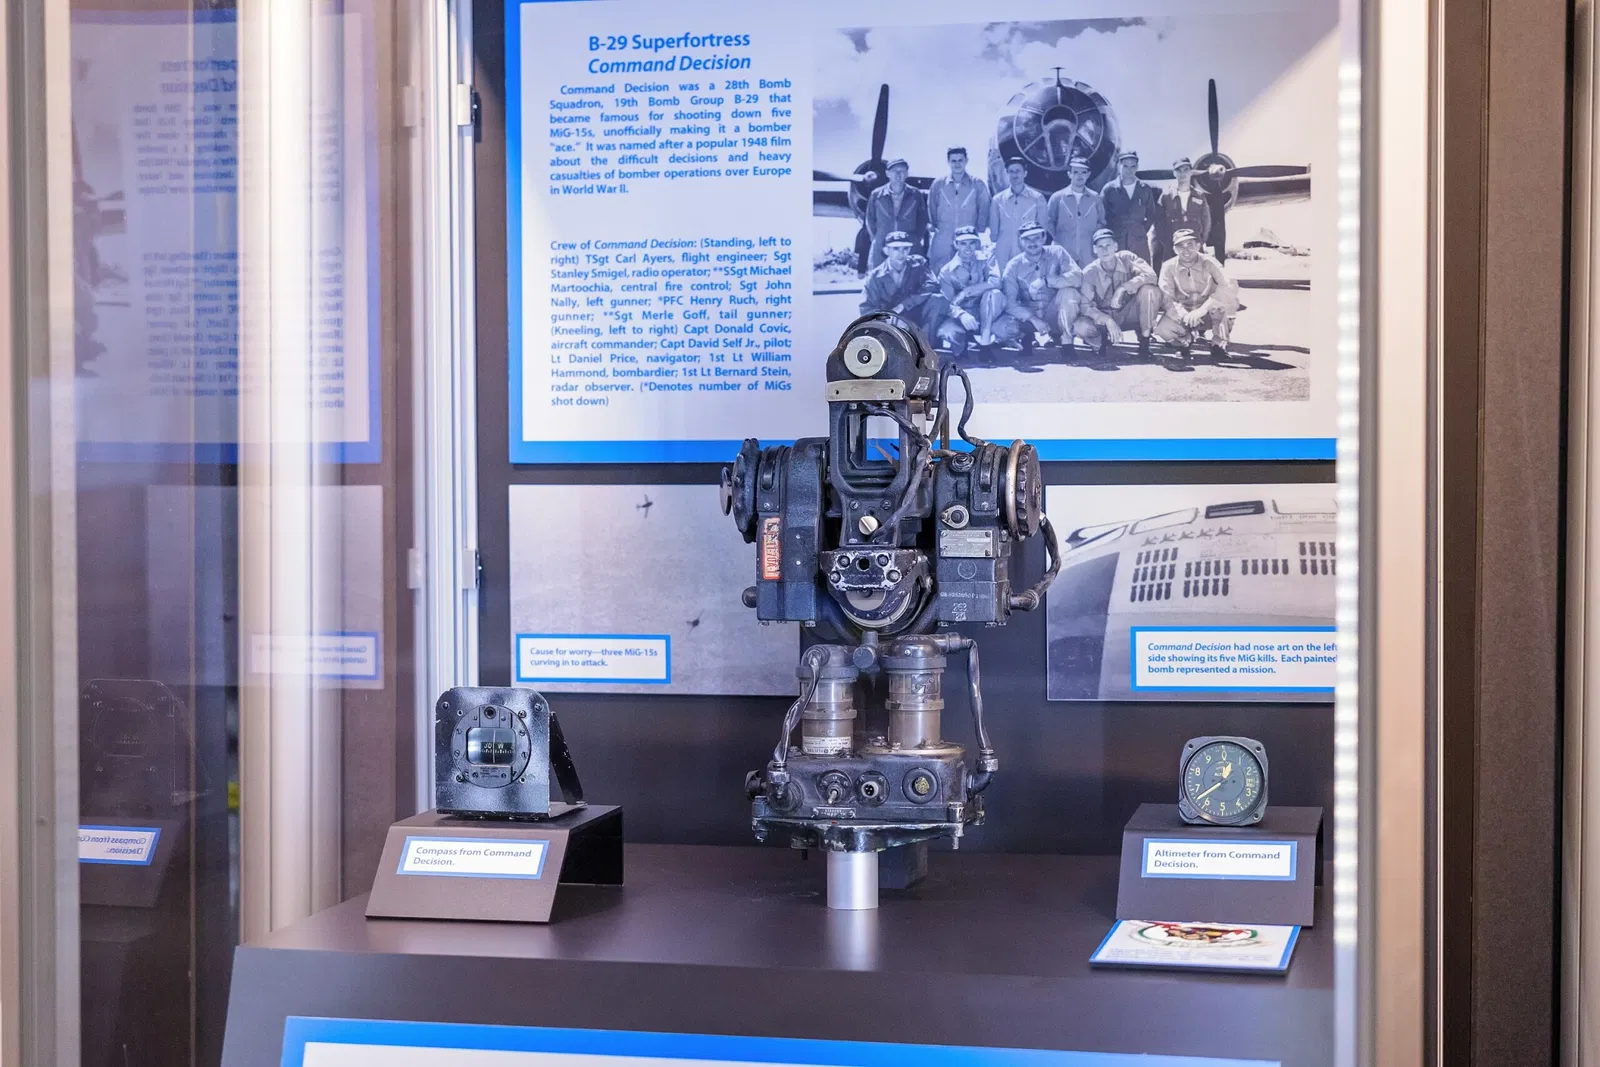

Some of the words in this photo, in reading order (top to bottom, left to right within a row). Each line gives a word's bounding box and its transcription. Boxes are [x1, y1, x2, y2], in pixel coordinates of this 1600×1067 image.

[589, 35, 628, 51] B-29
[632, 32, 750, 53] Superfortress
[588, 55, 676, 74] Command
[679, 54, 751, 71] Decision
[560, 83, 615, 95] Command
[624, 82, 670, 93] Decision
[679, 83, 700, 91] was
[708, 82, 716, 90] a
[724, 80, 750, 90] 28th
[759, 78, 792, 89] Bomb
[550, 99, 604, 112] Squadron,
[615, 97, 638, 108] 19th
[648, 96, 680, 107] Bomb
[690, 95, 724, 107] Group
[734, 94, 759, 104] B-29
[769, 93, 792, 103] that
[549, 114, 591, 124] became
[600, 112, 640, 122] famous
[648, 110, 664, 121] for
[674, 110, 722, 122] shooting
[730, 108, 762, 119] down
[771, 107, 792, 118] five
[550, 128, 595, 138] MiG-15s,
[603, 125, 662, 138] unofficially
[670, 124, 710, 136] making
[718, 124, 726, 134] it
[734, 125, 740, 133] a
[748, 122, 792, 133] bomber
[586, 142, 593, 151] It
[596, 143, 616, 151] was
[619, 140, 656, 150] named
[658, 139, 684, 149] after
[686, 141, 693, 149] a
[696, 138, 738, 151] popular
[742, 137, 768, 147] 1948
[770, 136, 792, 146] film
[550, 156, 581, 167] about
[590, 156, 608, 166] the
[618, 154, 658, 165] difficult
[668, 153, 718, 164] decisions
[728, 151, 749, 162] and
[758, 151, 792, 163] heavy
[550, 170, 601, 181] casualties
[604, 169, 615, 180] of
[618, 168, 660, 179] bomber
[664, 168, 722, 180] operations
[725, 168, 750, 176] over
[752, 166, 792, 178] Europe
[550, 185, 560, 194] in
[562, 184, 594, 195] World
[596, 184, 618, 194] War
[550, 241, 577, 250] Crew
[580, 240, 591, 250] of
[594, 239, 648, 250] Command
[650, 238, 697, 249] Decision:
[700, 237, 755, 250] (Standing,
[758, 236, 777, 247] left
[780, 237, 792, 246] to
[551, 255, 579, 267] right)
[585, 254, 609, 266] TSgt
[615, 254, 636, 263] Carl
[642, 253, 675, 265] Ayers,
[681, 252, 710, 265] flight
[716, 252, 768, 264] engineer;
[774, 250, 792, 264] Sgt
[551, 282, 612, 293] Martoochia,
[620, 281, 657, 292] central
[664, 280, 683, 291] fire
[690, 280, 732, 291] control;
[740, 280, 758, 293] Sgt
[765, 280, 792, 290] John
[552, 325, 603, 338] (Kneeling,
[609, 324, 626, 335] left
[632, 326, 643, 334] to
[649, 324, 678, 337] right)
[683, 324, 709, 336] Capt
[714, 323, 754, 334] Donald
[759, 323, 791, 334] Covic,
[551, 339, 588, 349] aircraft
[590, 339, 658, 349] commander;
[660, 338, 685, 351] Capt
[688, 338, 720, 348] David
[722, 337, 743, 348] Self
[745, 338, 760, 348] Jr.,
[764, 337, 792, 350] pilot;
[551, 355, 560, 364] Lt
[569, 353, 602, 363] Daniel
[610, 353, 638, 364] Price,
[646, 353, 700, 365] navigator;
[709, 352, 725, 362] 1st
[732, 352, 743, 362] Lt
[751, 351, 792, 362] William
[551, 368, 609, 378] Hammond,
[612, 367, 678, 378] bombardier;
[682, 367, 698, 377] 1st
[701, 367, 711, 377] Lt
[714, 366, 758, 377] Bernard
[761, 366, 792, 377] Stein,
[551, 396, 574, 406] shot
[576, 396, 609, 406] down)
[624, 648, 659, 656] MiG-15s
[1148, 642, 1193, 651] Command
[1194, 642, 1232, 651] Decision
[1233, 642, 1251, 651] had
[1306, 643, 1322, 651] the
[530, 659, 560, 668] curving
[581, 658, 608, 666] attack.
[1148, 654, 1166, 662] side
[1168, 654, 1206, 664] showing
[1207, 654, 1218, 662] its
[1219, 654, 1236, 662] five
[1237, 654, 1256, 662] MiG
[1257, 654, 1278, 662] kills.
[1281, 654, 1302, 662] Each
[1148, 665, 1175, 673] bomb
[1176, 665, 1230, 675] represented
[1239, 666, 1276, 674] mission.
[416, 846, 458, 856] Compass
[459, 848, 482, 856] from
[483, 848, 532, 858] Command
[1154, 850, 1201, 858] Altimeter
[1203, 850, 1227, 858] from
[1228, 851, 1280, 859] Command
[413, 857, 454, 866] Decision.
[1154, 860, 1198, 868] Decision.
